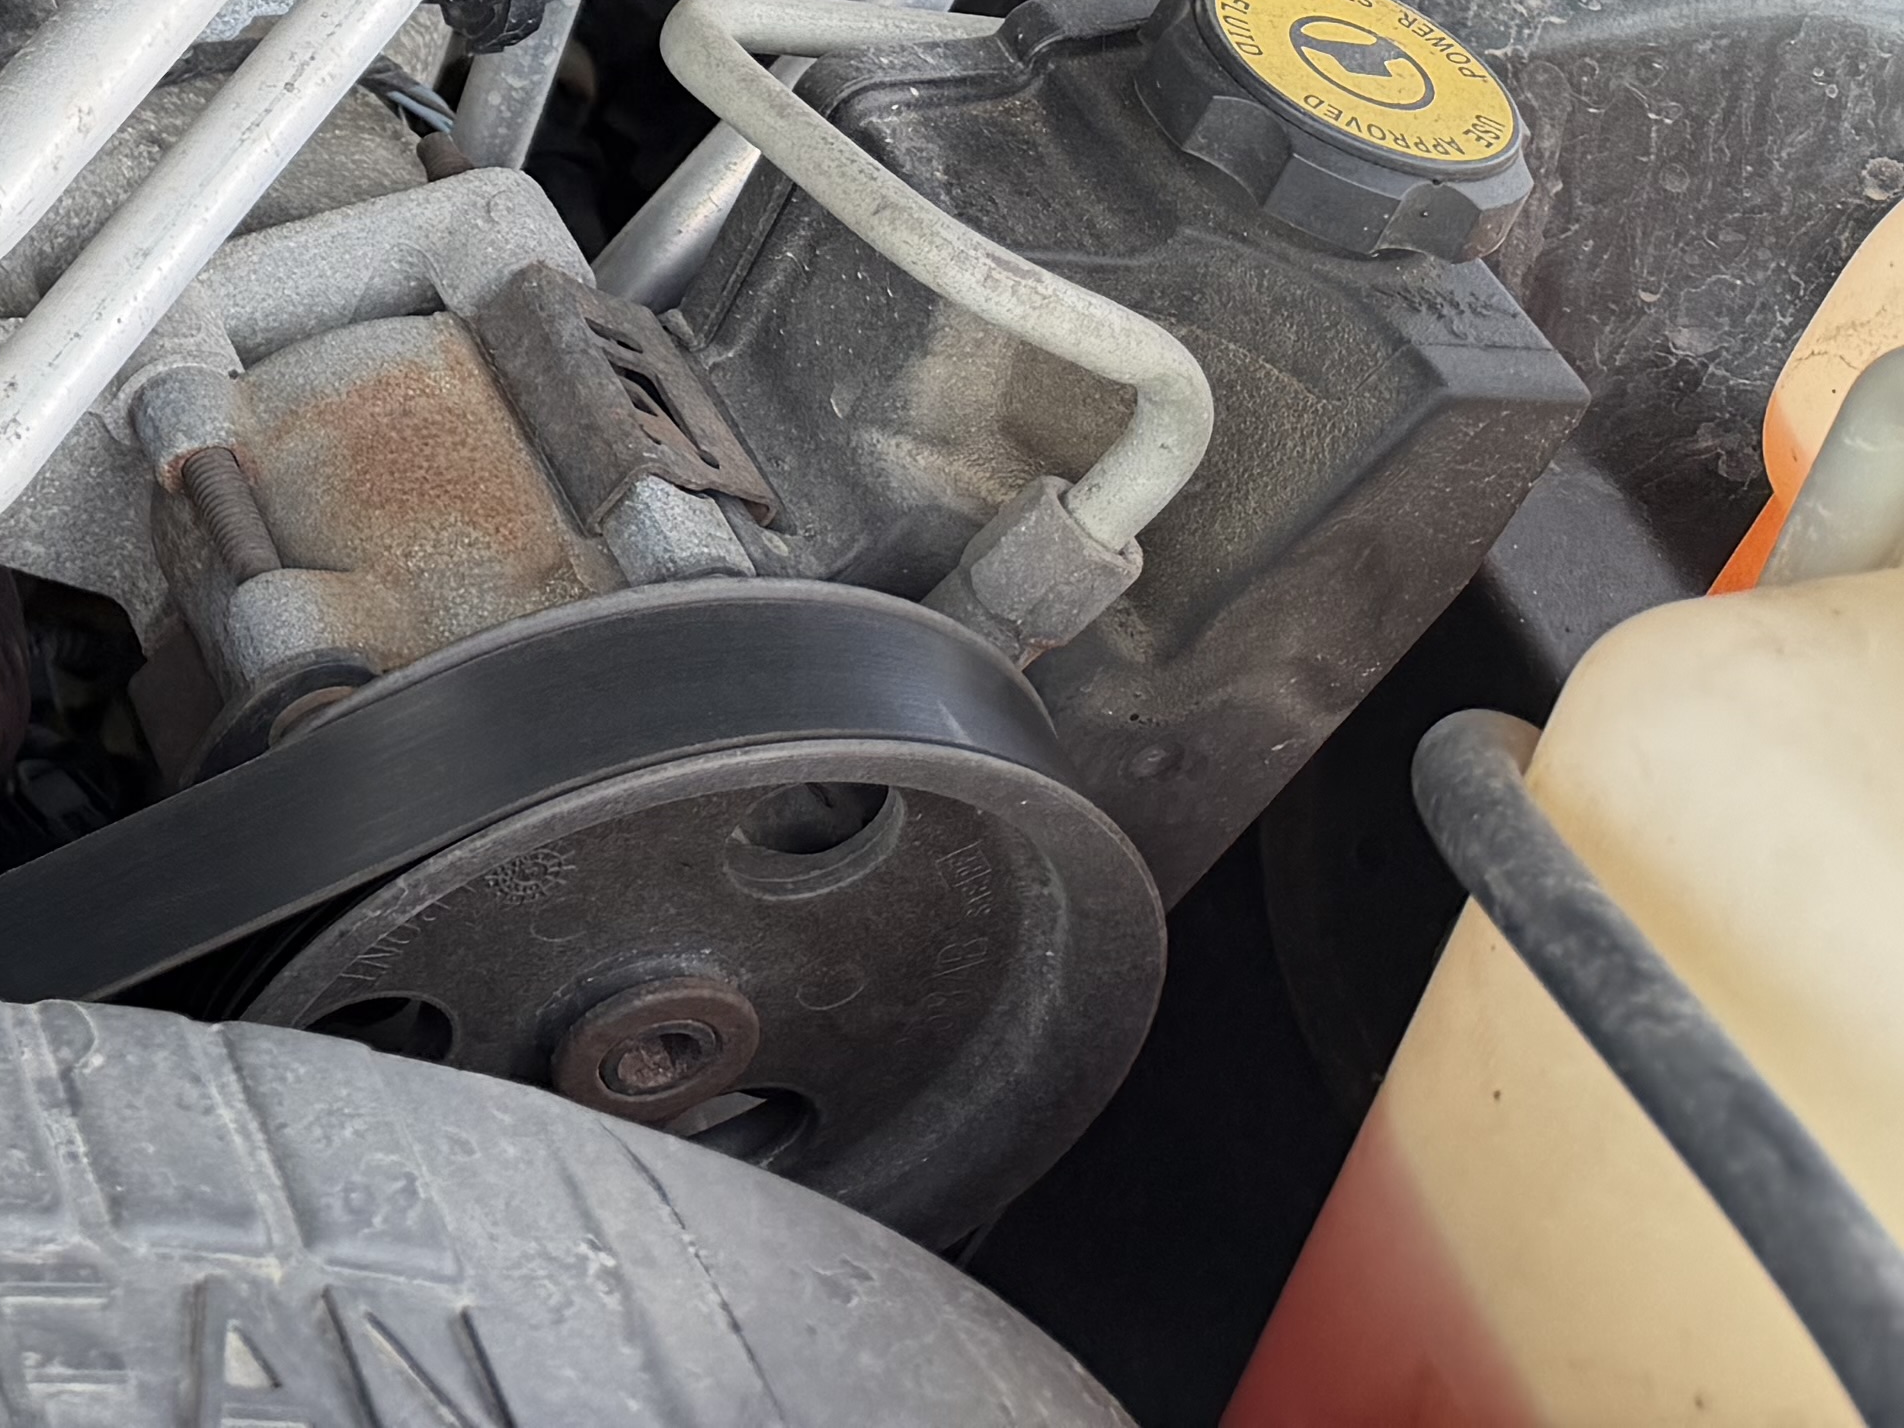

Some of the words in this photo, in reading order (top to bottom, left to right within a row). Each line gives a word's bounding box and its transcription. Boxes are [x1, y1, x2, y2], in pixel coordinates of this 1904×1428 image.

[1397, 11, 1488, 81] POWER
[1303, 93, 1466, 157] APPROVED
[1463, 114, 1507, 149] USE
